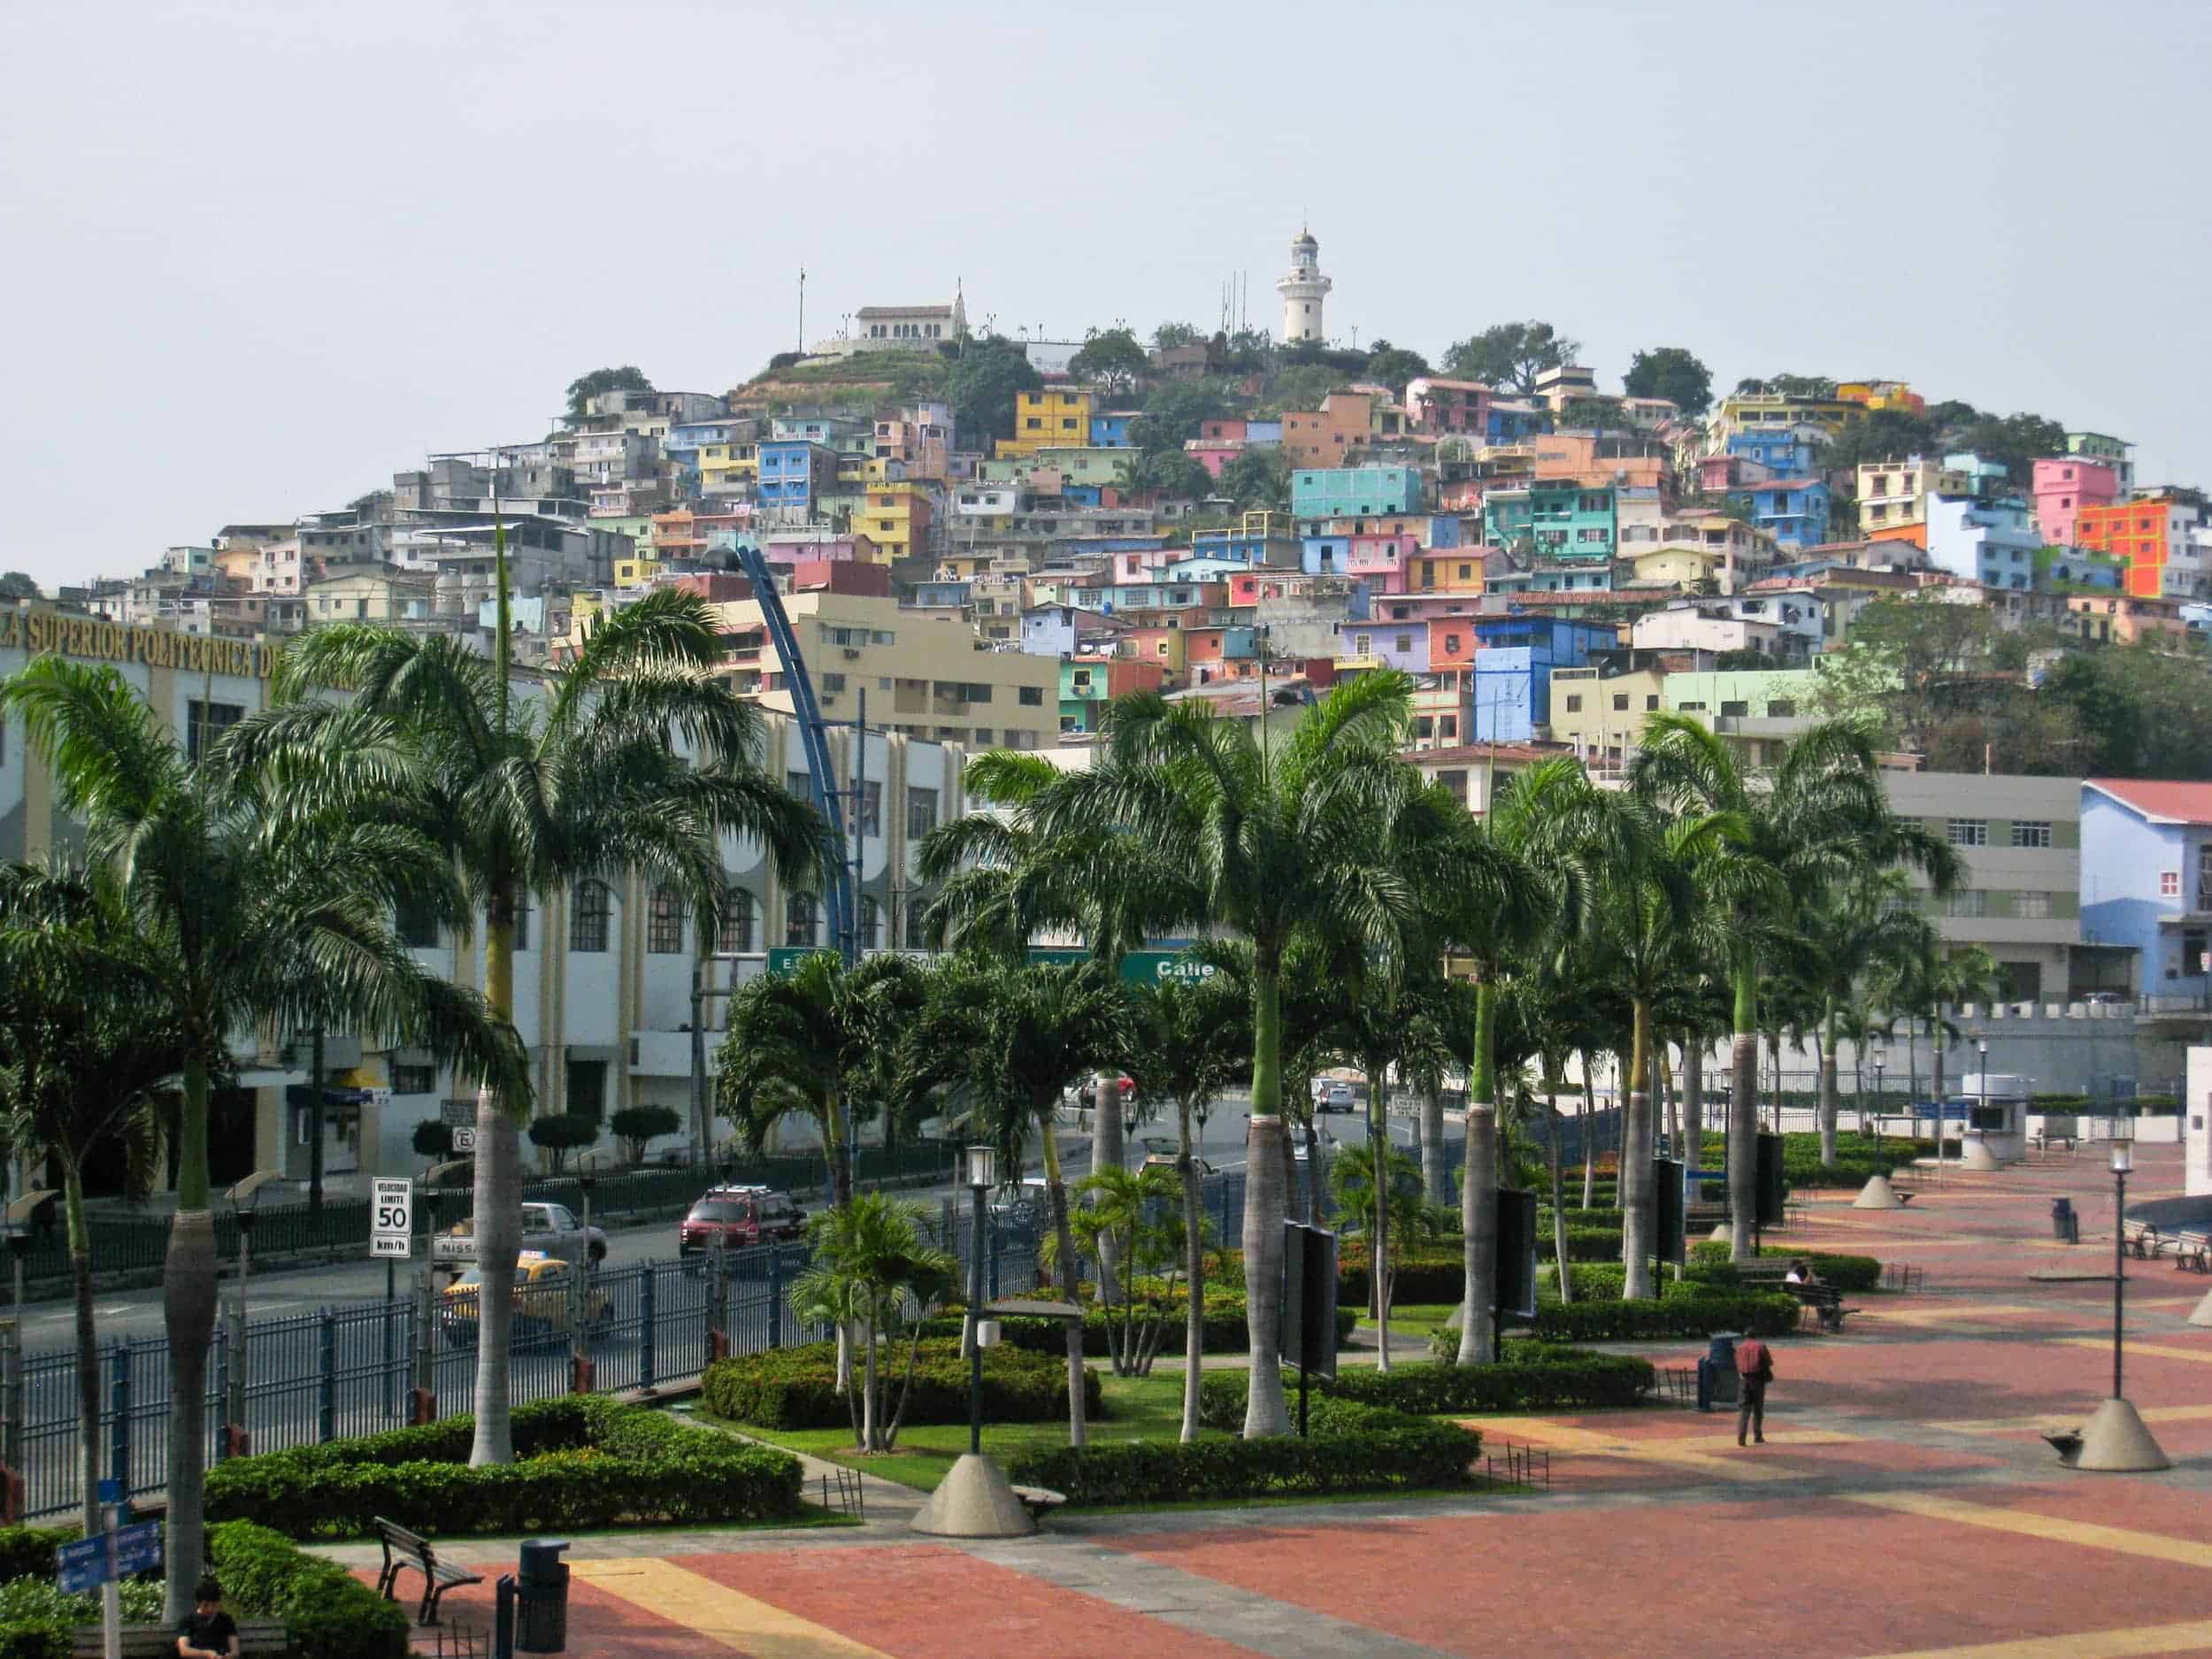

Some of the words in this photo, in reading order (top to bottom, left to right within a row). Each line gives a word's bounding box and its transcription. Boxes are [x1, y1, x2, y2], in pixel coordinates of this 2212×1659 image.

[28, 615, 128, 660] SUPERIOR
[133, 627, 255, 680] POLITECNICA
[1156, 961, 1215, 977] Calle
[378, 1182, 408, 1193] VELOCIDAD
[380, 1194, 404, 1204] LIMITE
[378, 1207, 407, 1228] 50
[376, 1240, 405, 1251] km/h
